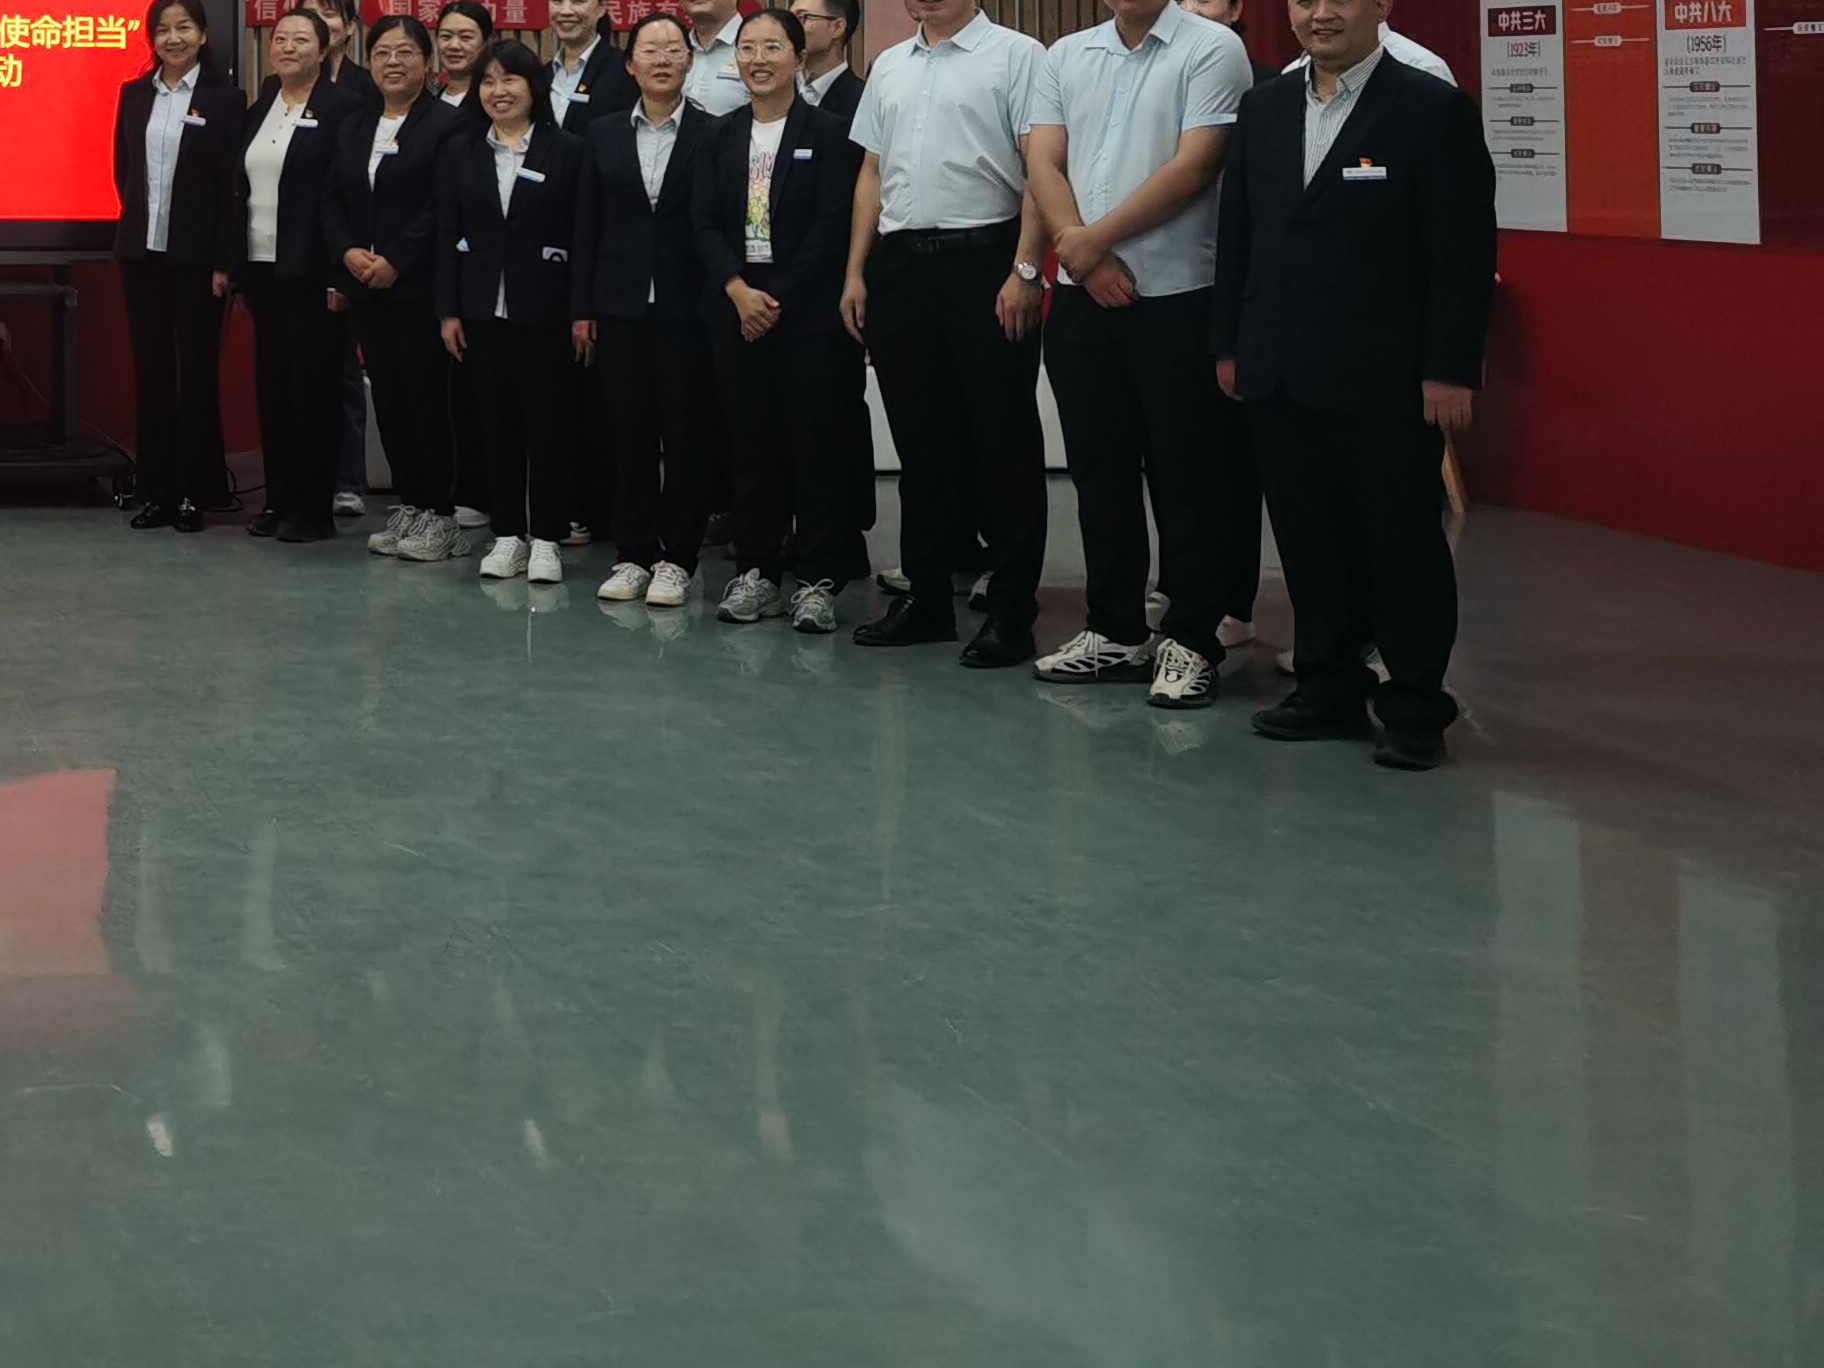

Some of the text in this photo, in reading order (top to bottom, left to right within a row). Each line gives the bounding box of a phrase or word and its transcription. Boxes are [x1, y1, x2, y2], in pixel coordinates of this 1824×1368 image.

[1497, 9, 1547, 32] 中共三大
[1674, 1, 1732, 24] 中共八大
